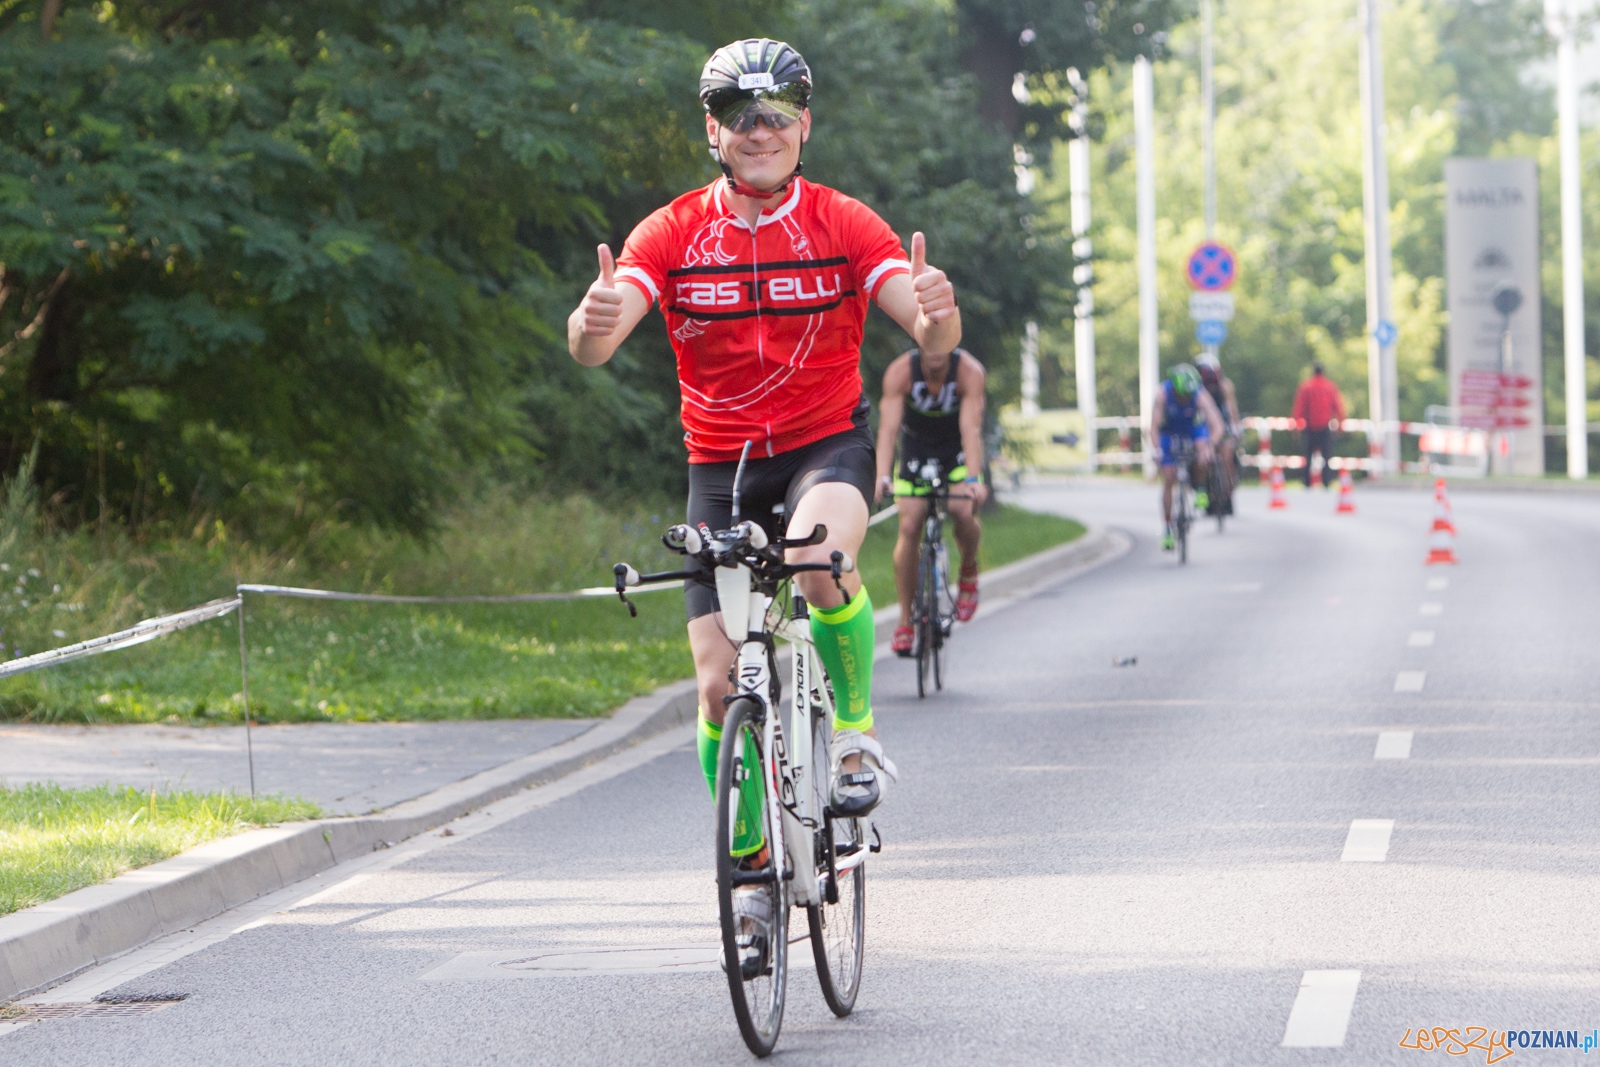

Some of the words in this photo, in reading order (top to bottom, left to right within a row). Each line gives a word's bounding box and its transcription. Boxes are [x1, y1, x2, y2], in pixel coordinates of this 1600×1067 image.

[750, 76, 762, 85] 341
[796, 652, 805, 717] RIDLEY
[773, 705, 803, 823] IDLEY
